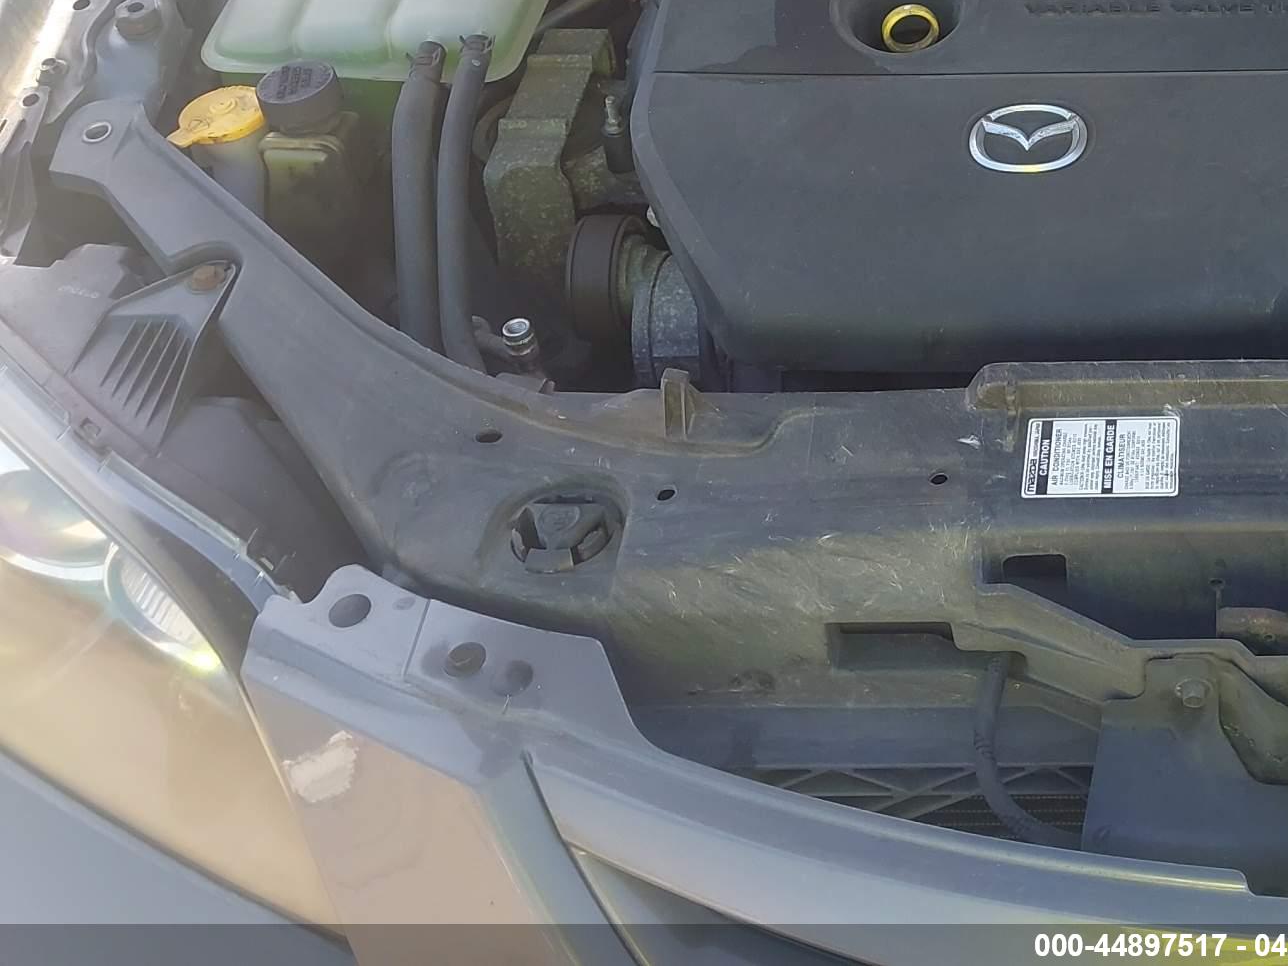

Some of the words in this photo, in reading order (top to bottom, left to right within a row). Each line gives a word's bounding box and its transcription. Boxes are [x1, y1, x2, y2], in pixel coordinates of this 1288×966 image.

[1024, 1, 1161, 15] VARIABLE
[1170, 0, 1255, 15] VALVE
[1052, 428, 1063, 472] CONDITIONER
[1105, 424, 1115, 453] GARDE
[1038, 439, 1051, 476] CAUTION
[1105, 455, 1113, 467] EN
[1117, 433, 1126, 479] CLIMATISEUR
[1026, 458, 1038, 493] mazda
[1051, 475, 1059, 486] AIR
[1103, 468, 1113, 489] MISE
